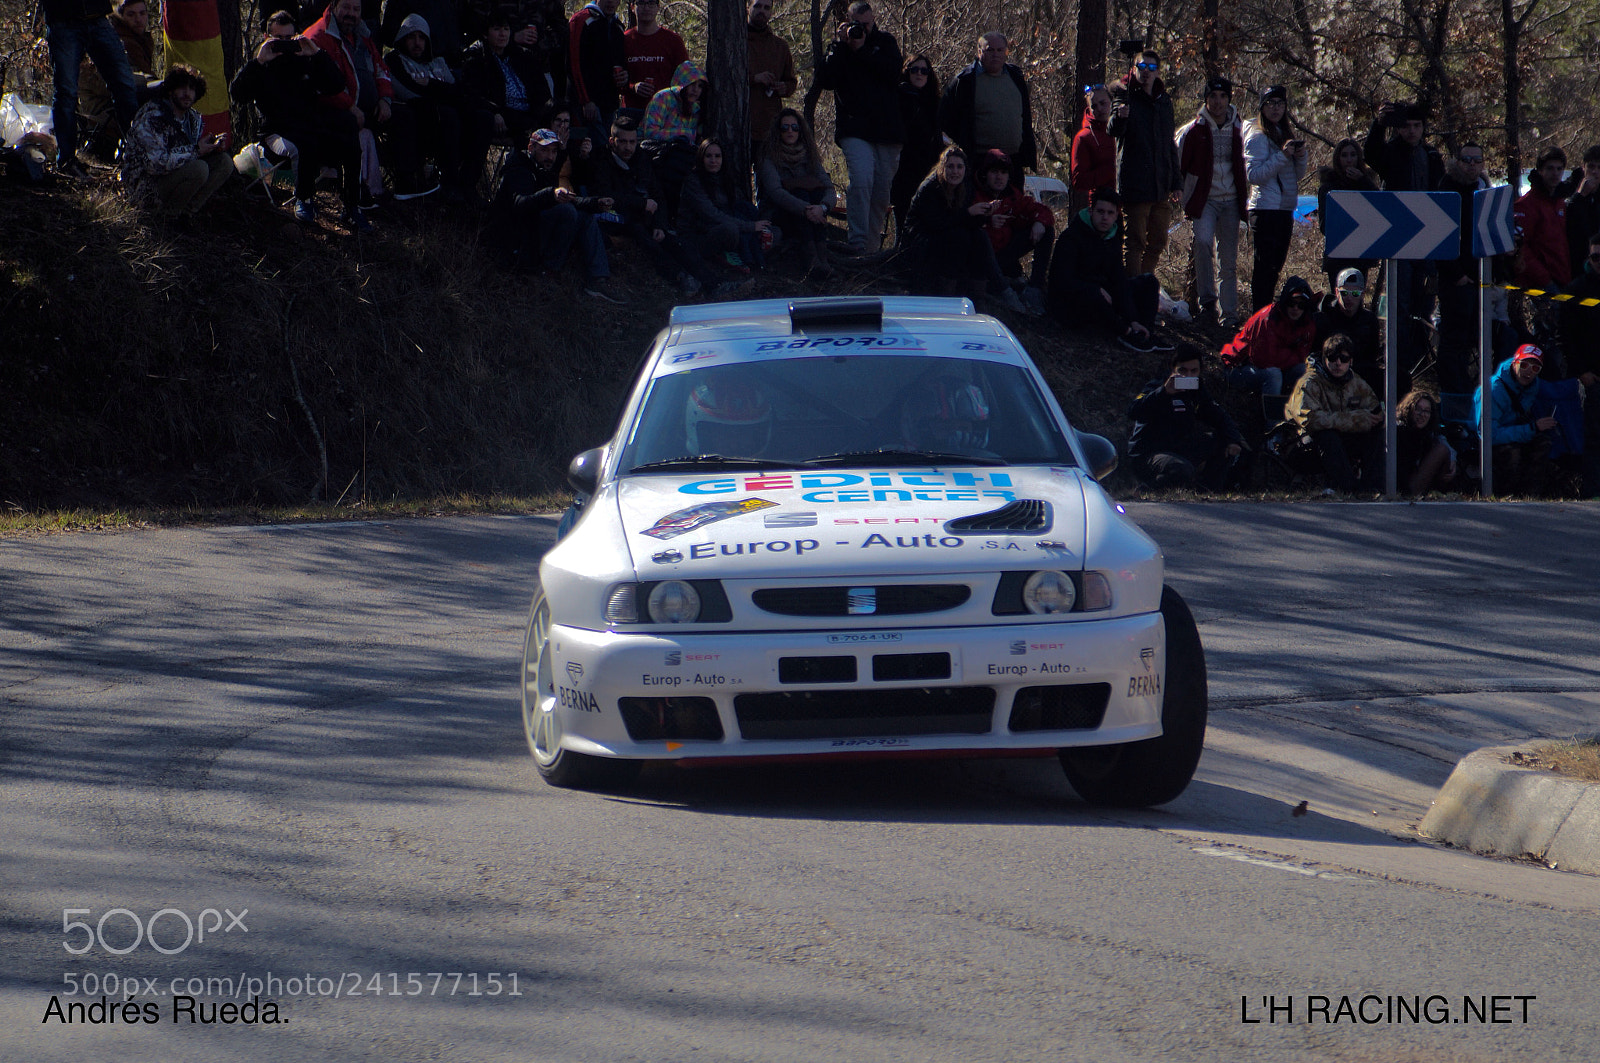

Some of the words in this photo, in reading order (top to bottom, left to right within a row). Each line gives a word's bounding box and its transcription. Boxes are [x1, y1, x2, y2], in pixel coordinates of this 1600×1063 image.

[627, 55, 665, 63] carhartt
[833, 517, 948, 526] SEAT
[689, 538, 821, 560] Europ
[860, 532, 966, 549] Auto
[685, 653, 722, 661] SEAT
[987, 663, 1029, 676] Europ
[1040, 662, 1072, 674] Auto
[642, 674, 682, 687] Europ
[693, 673, 726, 685] Auto
[1126, 673, 1162, 698] BERNA
[559, 686, 602, 713] BERNA
